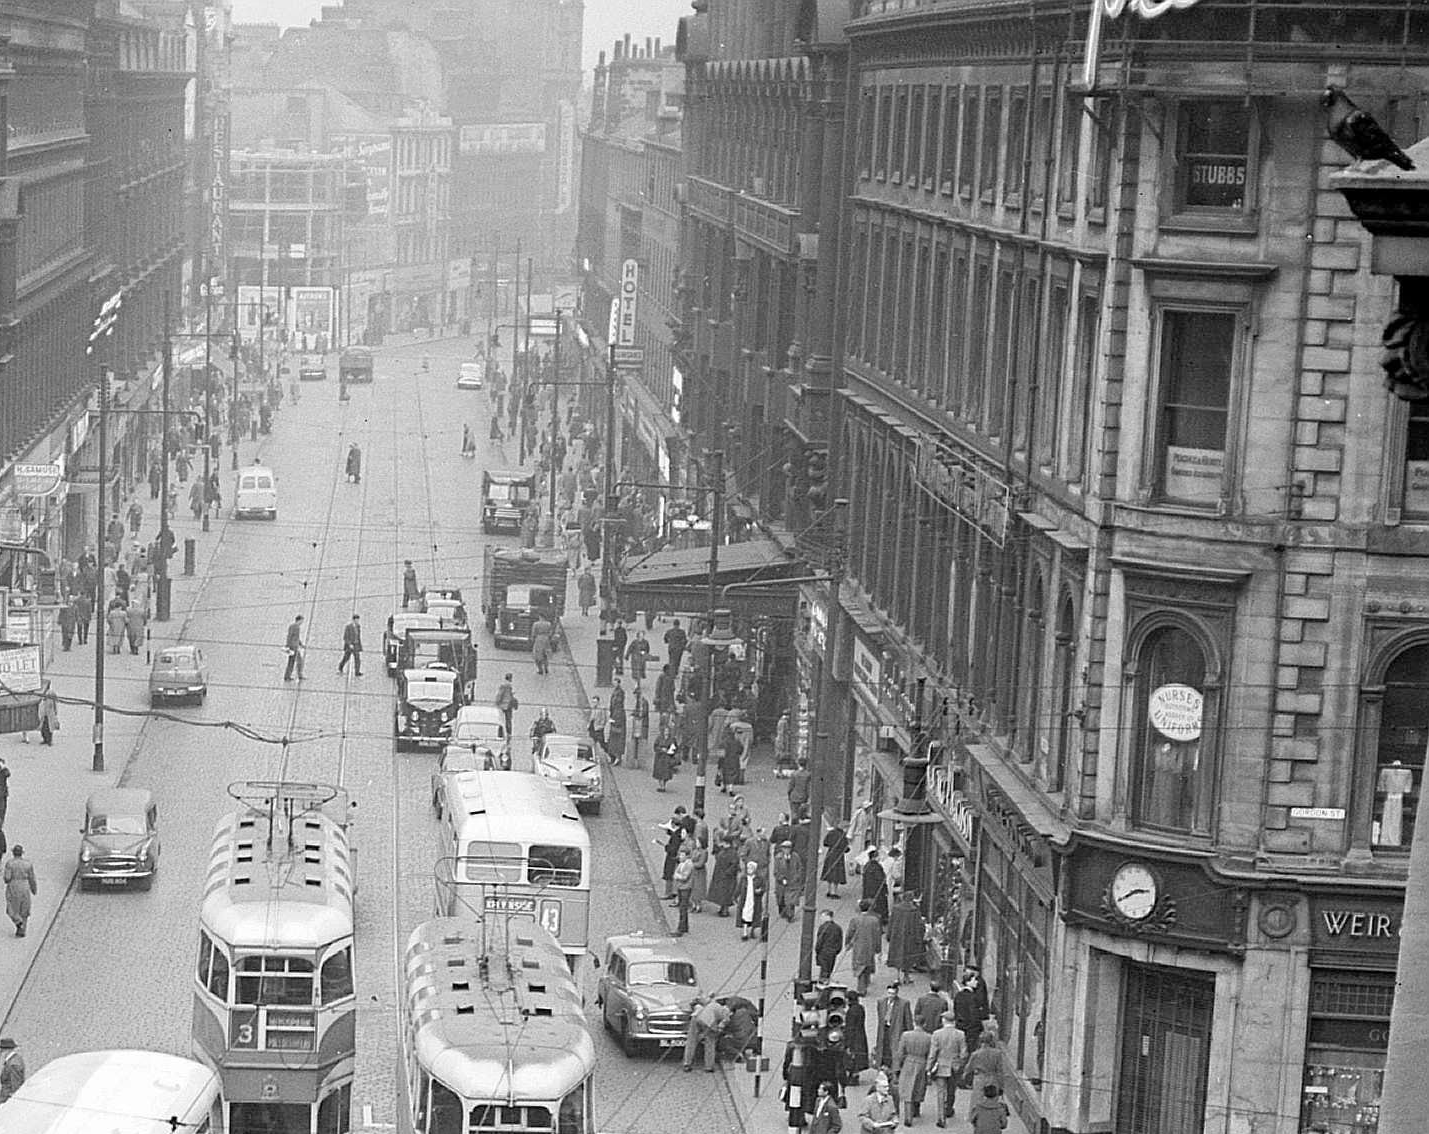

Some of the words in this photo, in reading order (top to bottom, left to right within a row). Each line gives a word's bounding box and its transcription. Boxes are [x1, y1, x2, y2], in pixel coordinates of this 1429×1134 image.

[1193, 164, 1246, 184] STUBBS
[622, 263, 637, 343] HOTEL
[1293, 809, 1327, 817] GORDON
[1322, 911, 1392, 938] WEIR
[238, 1024, 253, 1043] 3
